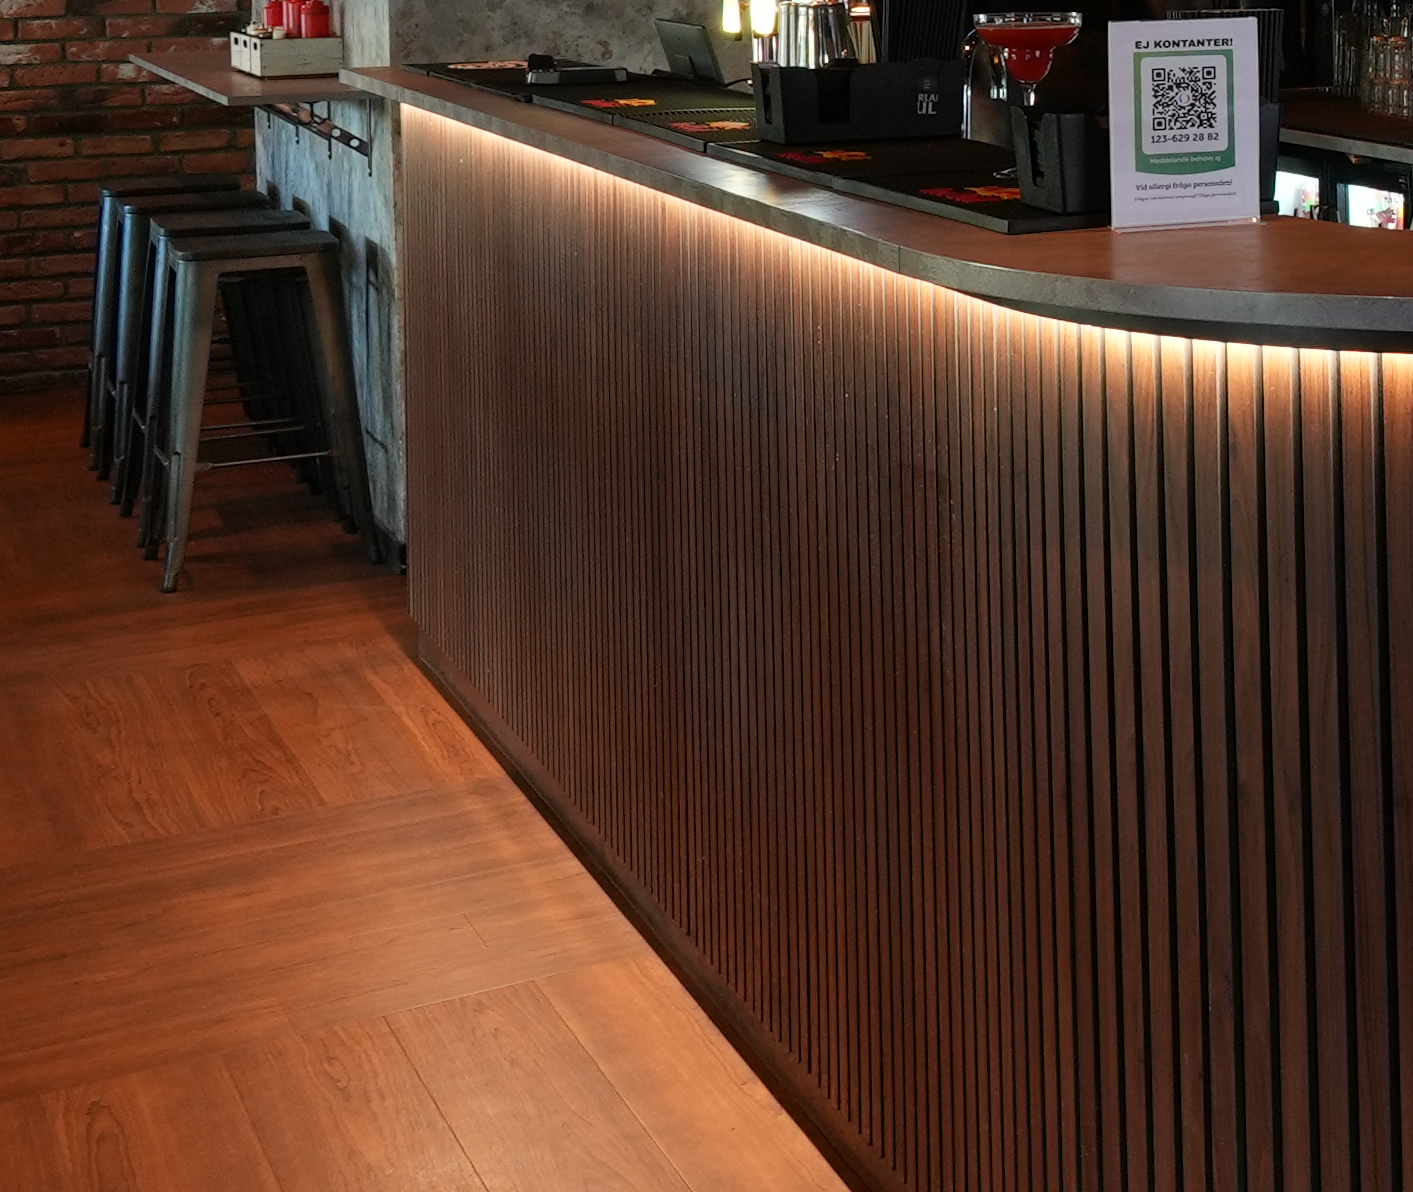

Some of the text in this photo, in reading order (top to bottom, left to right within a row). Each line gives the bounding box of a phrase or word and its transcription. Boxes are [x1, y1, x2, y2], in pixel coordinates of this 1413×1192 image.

[1135, 38, 1233, 49] EJ KONTANTER!
[1151, 134, 1190, 144] 123-629
[1193, 133, 1205, 142] 28
[1172, 181, 1192, 190] fråga
